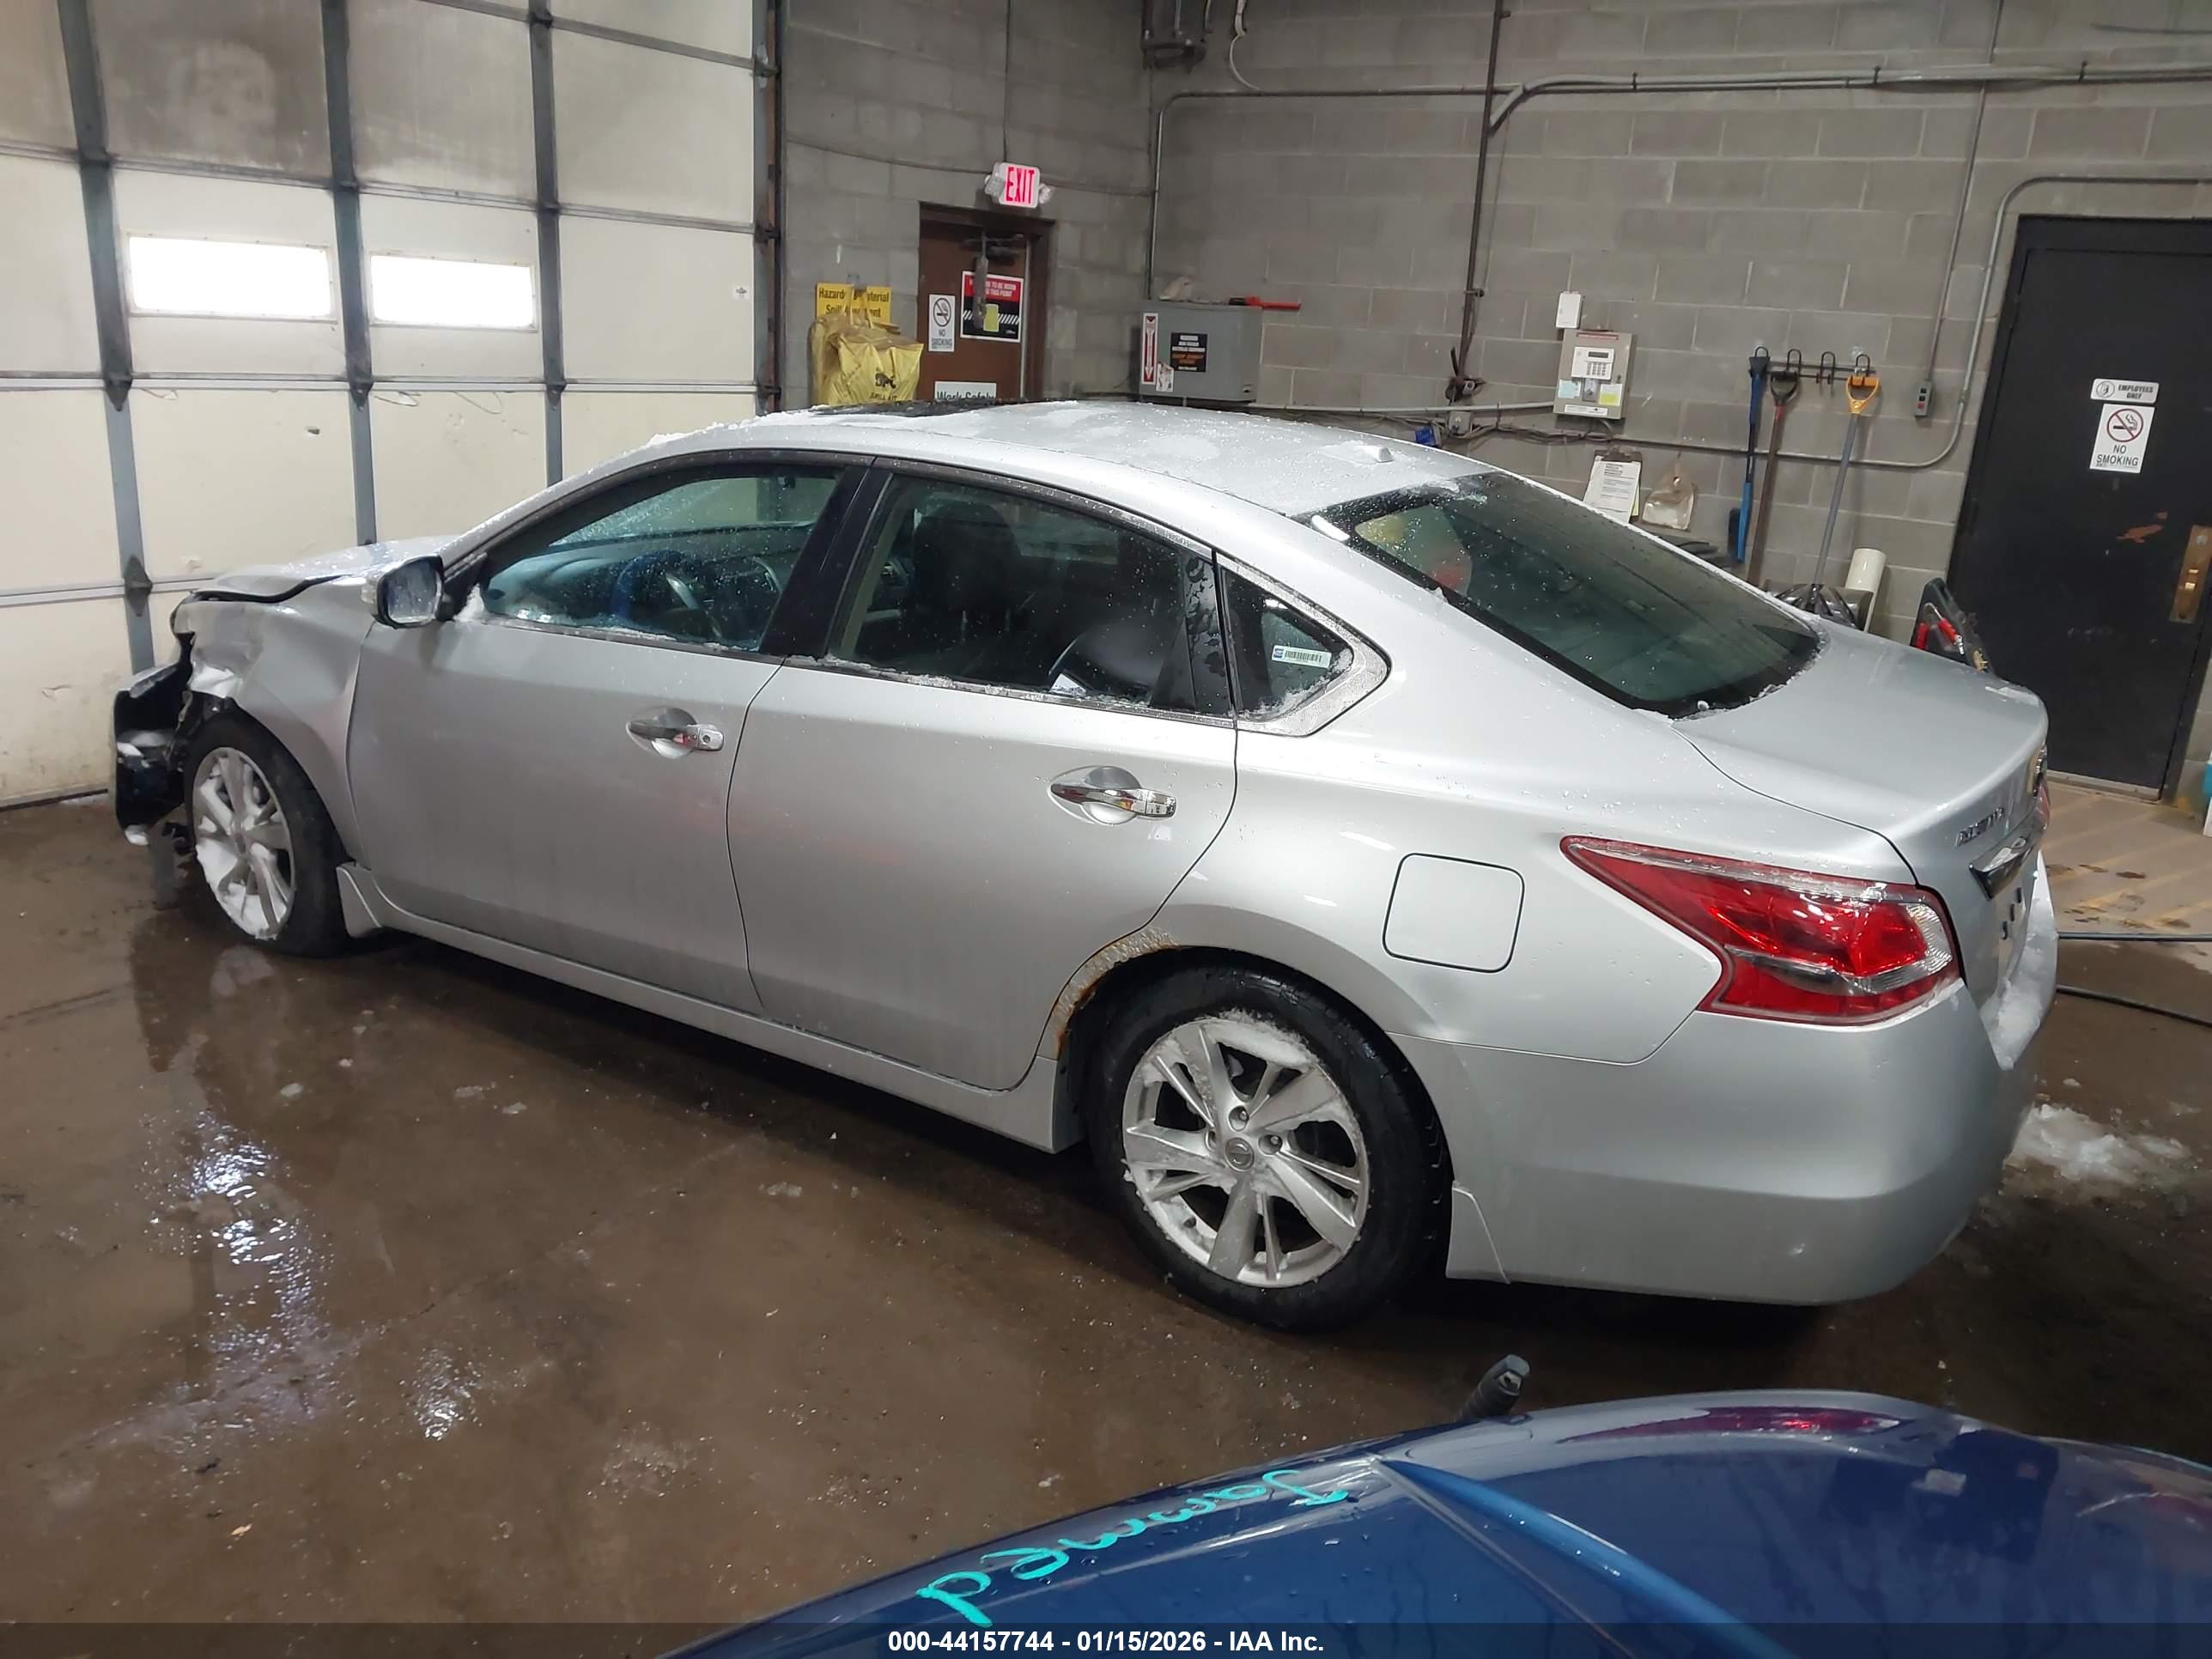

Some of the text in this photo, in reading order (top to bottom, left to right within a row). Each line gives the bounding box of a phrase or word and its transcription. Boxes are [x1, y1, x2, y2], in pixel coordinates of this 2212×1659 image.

[1006, 167, 1035, 204] EXIT
[819, 289, 858, 300] Hazards
[2113, 444, 2126, 453] NO
[2096, 454, 2139, 466] SMOKING
